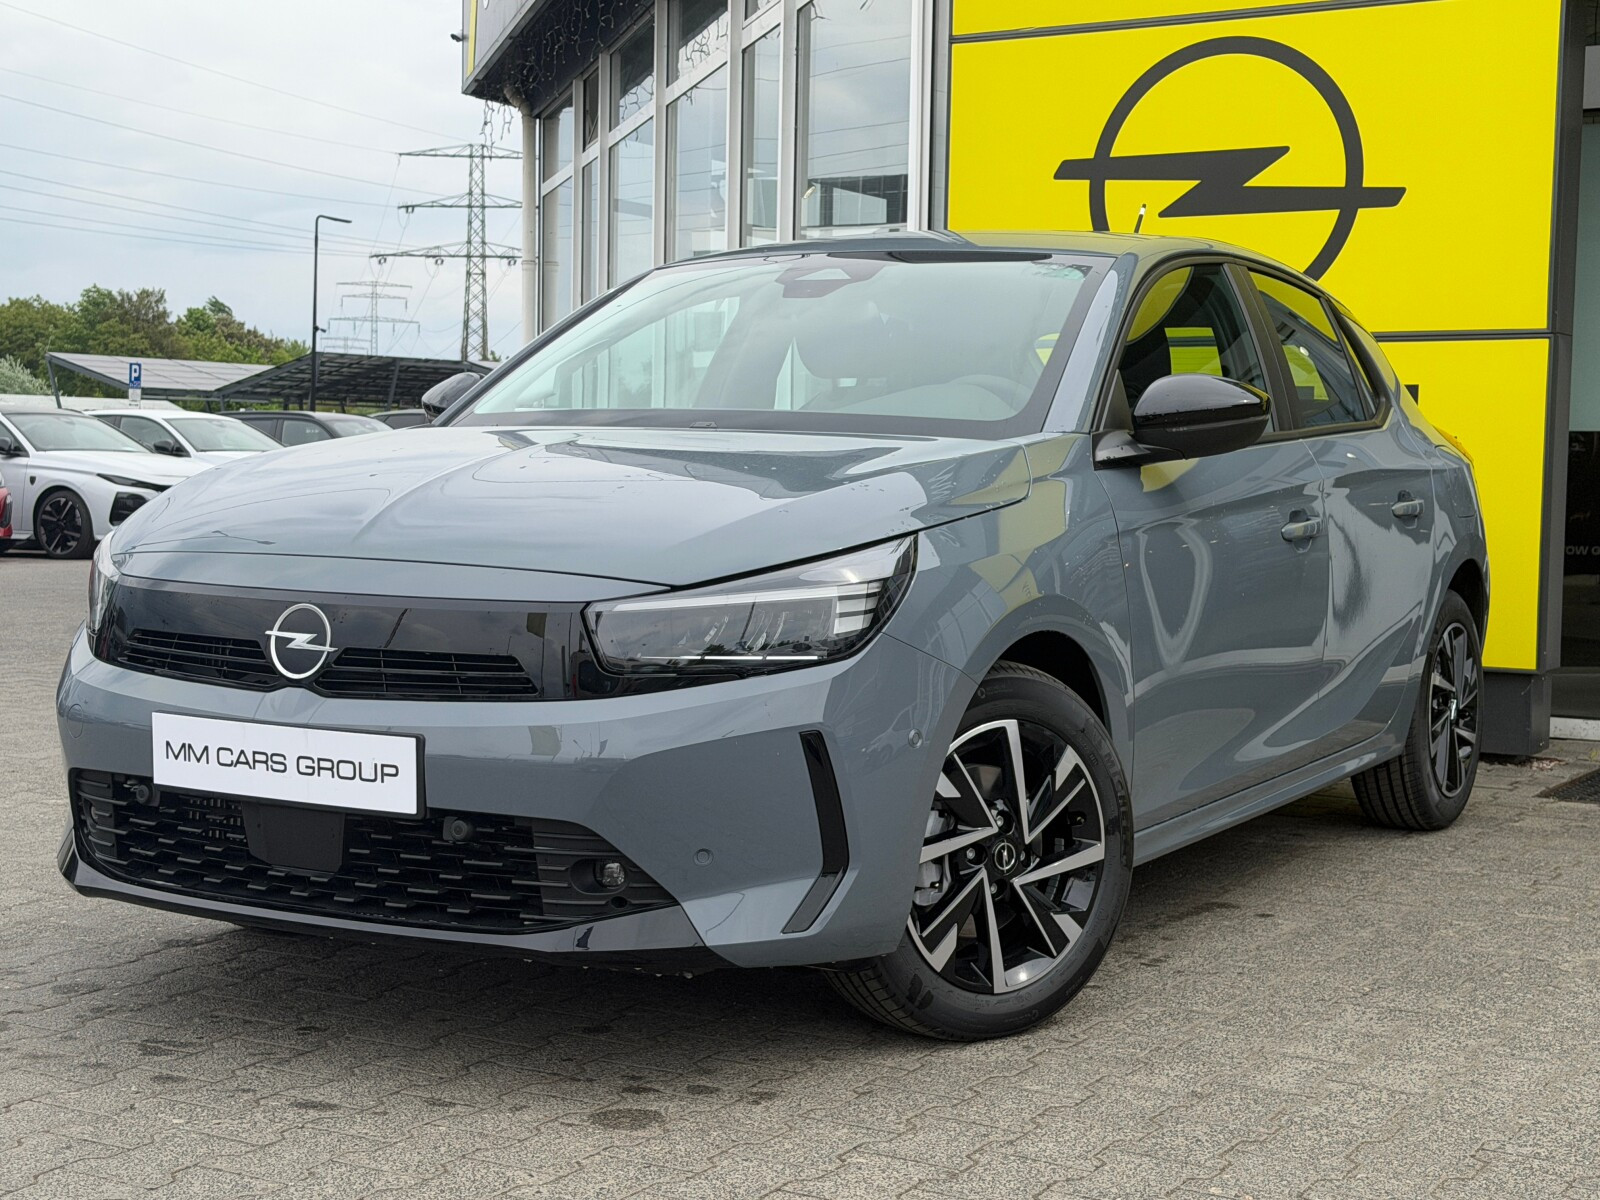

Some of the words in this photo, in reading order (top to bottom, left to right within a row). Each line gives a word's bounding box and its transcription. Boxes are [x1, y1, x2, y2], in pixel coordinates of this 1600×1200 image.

[131, 364, 140, 381] P
[166, 741, 209, 765] MM
[217, 747, 288, 773] CARS
[296, 756, 399, 783] GROUP
